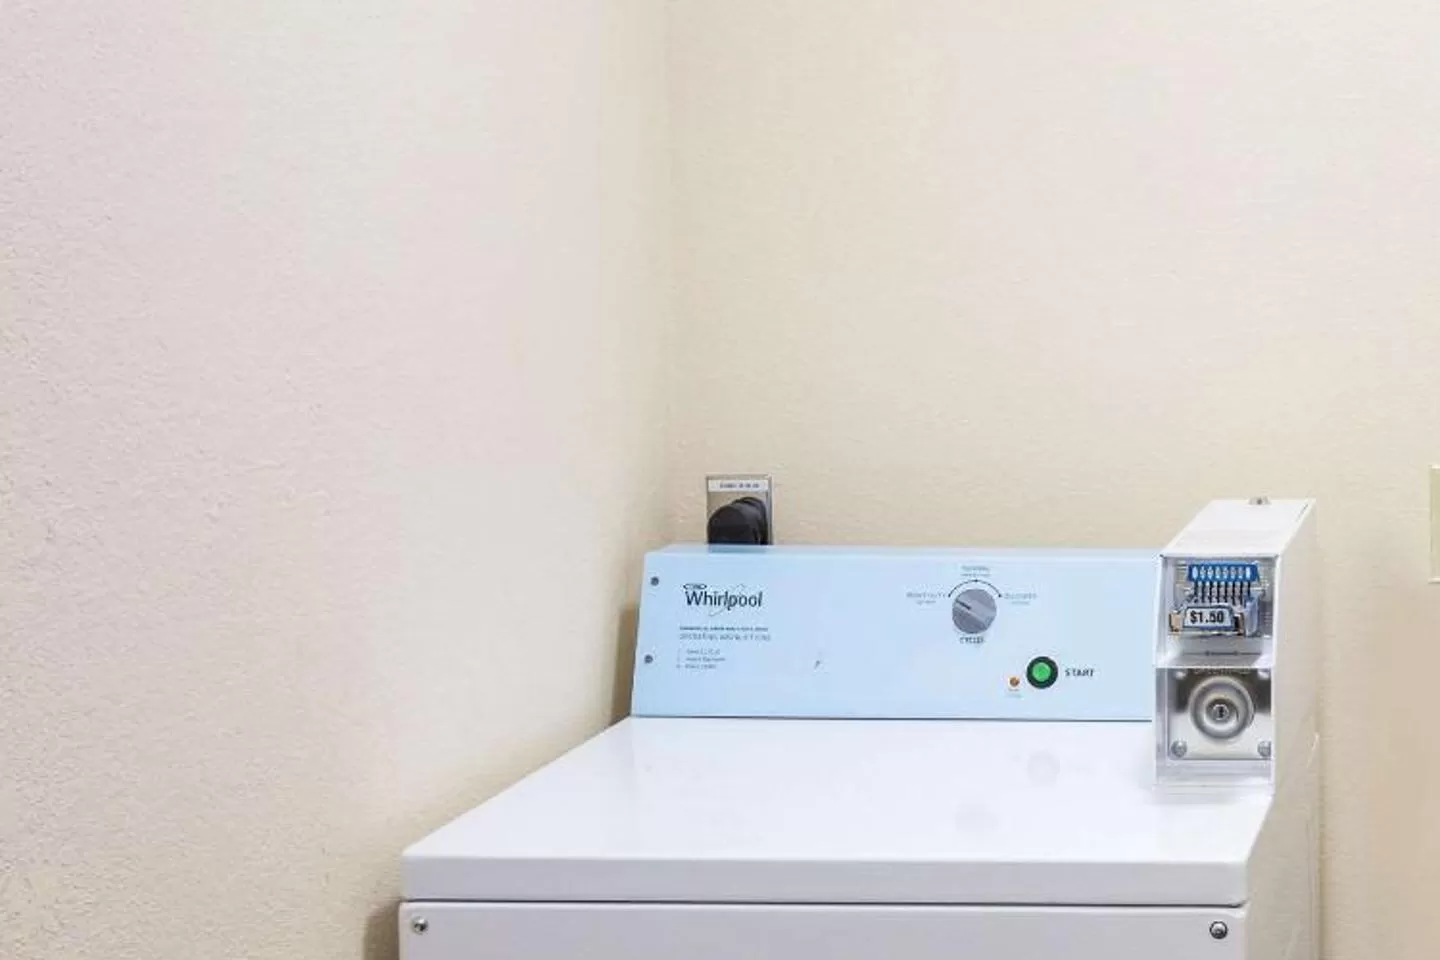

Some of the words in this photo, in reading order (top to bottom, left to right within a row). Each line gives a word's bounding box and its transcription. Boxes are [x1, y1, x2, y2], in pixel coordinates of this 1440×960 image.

[685, 591, 763, 611] Whirlpool
[1190, 610, 1224, 624] $1.50
[1064, 668, 1095, 678] START
